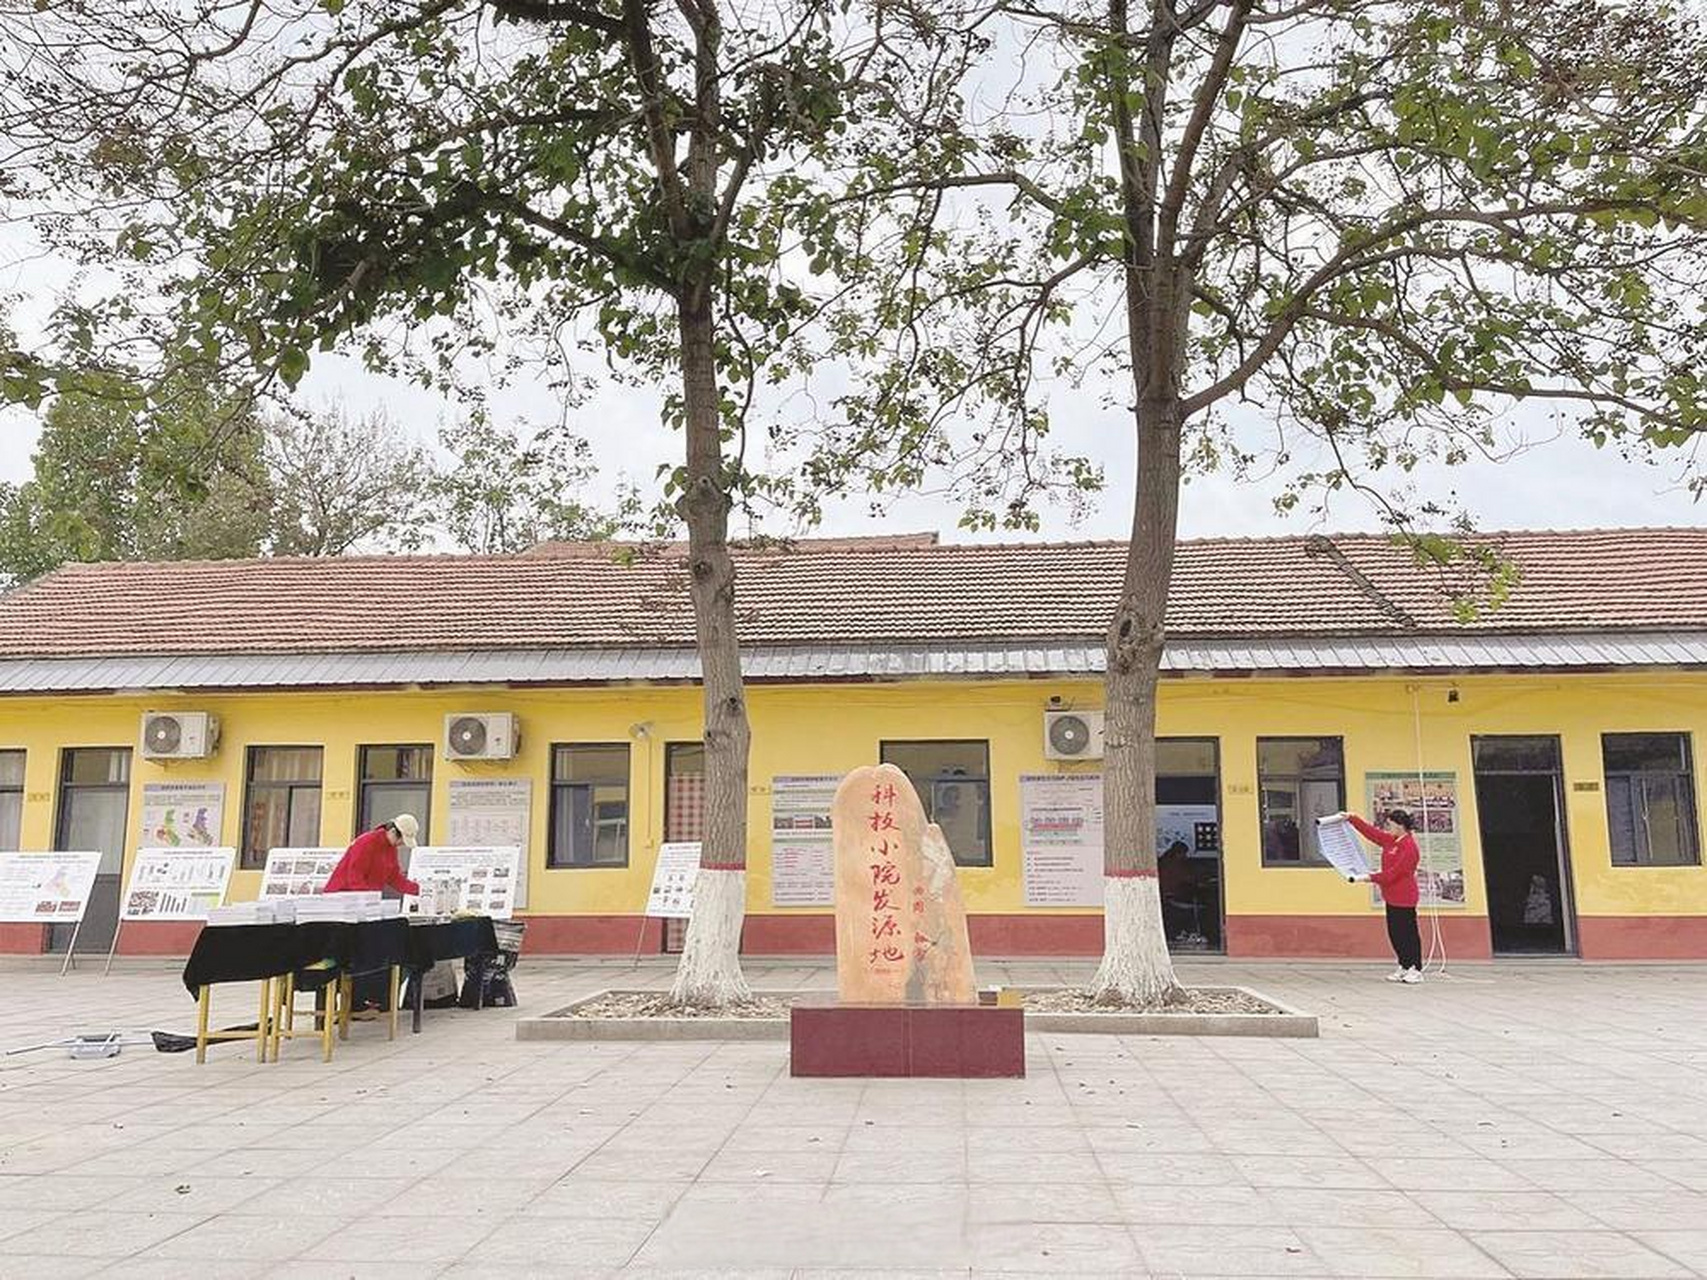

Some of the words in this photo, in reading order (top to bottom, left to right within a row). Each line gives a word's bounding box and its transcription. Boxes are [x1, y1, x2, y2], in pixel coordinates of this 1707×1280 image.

[868, 783, 904, 964] 科技小院发源地
